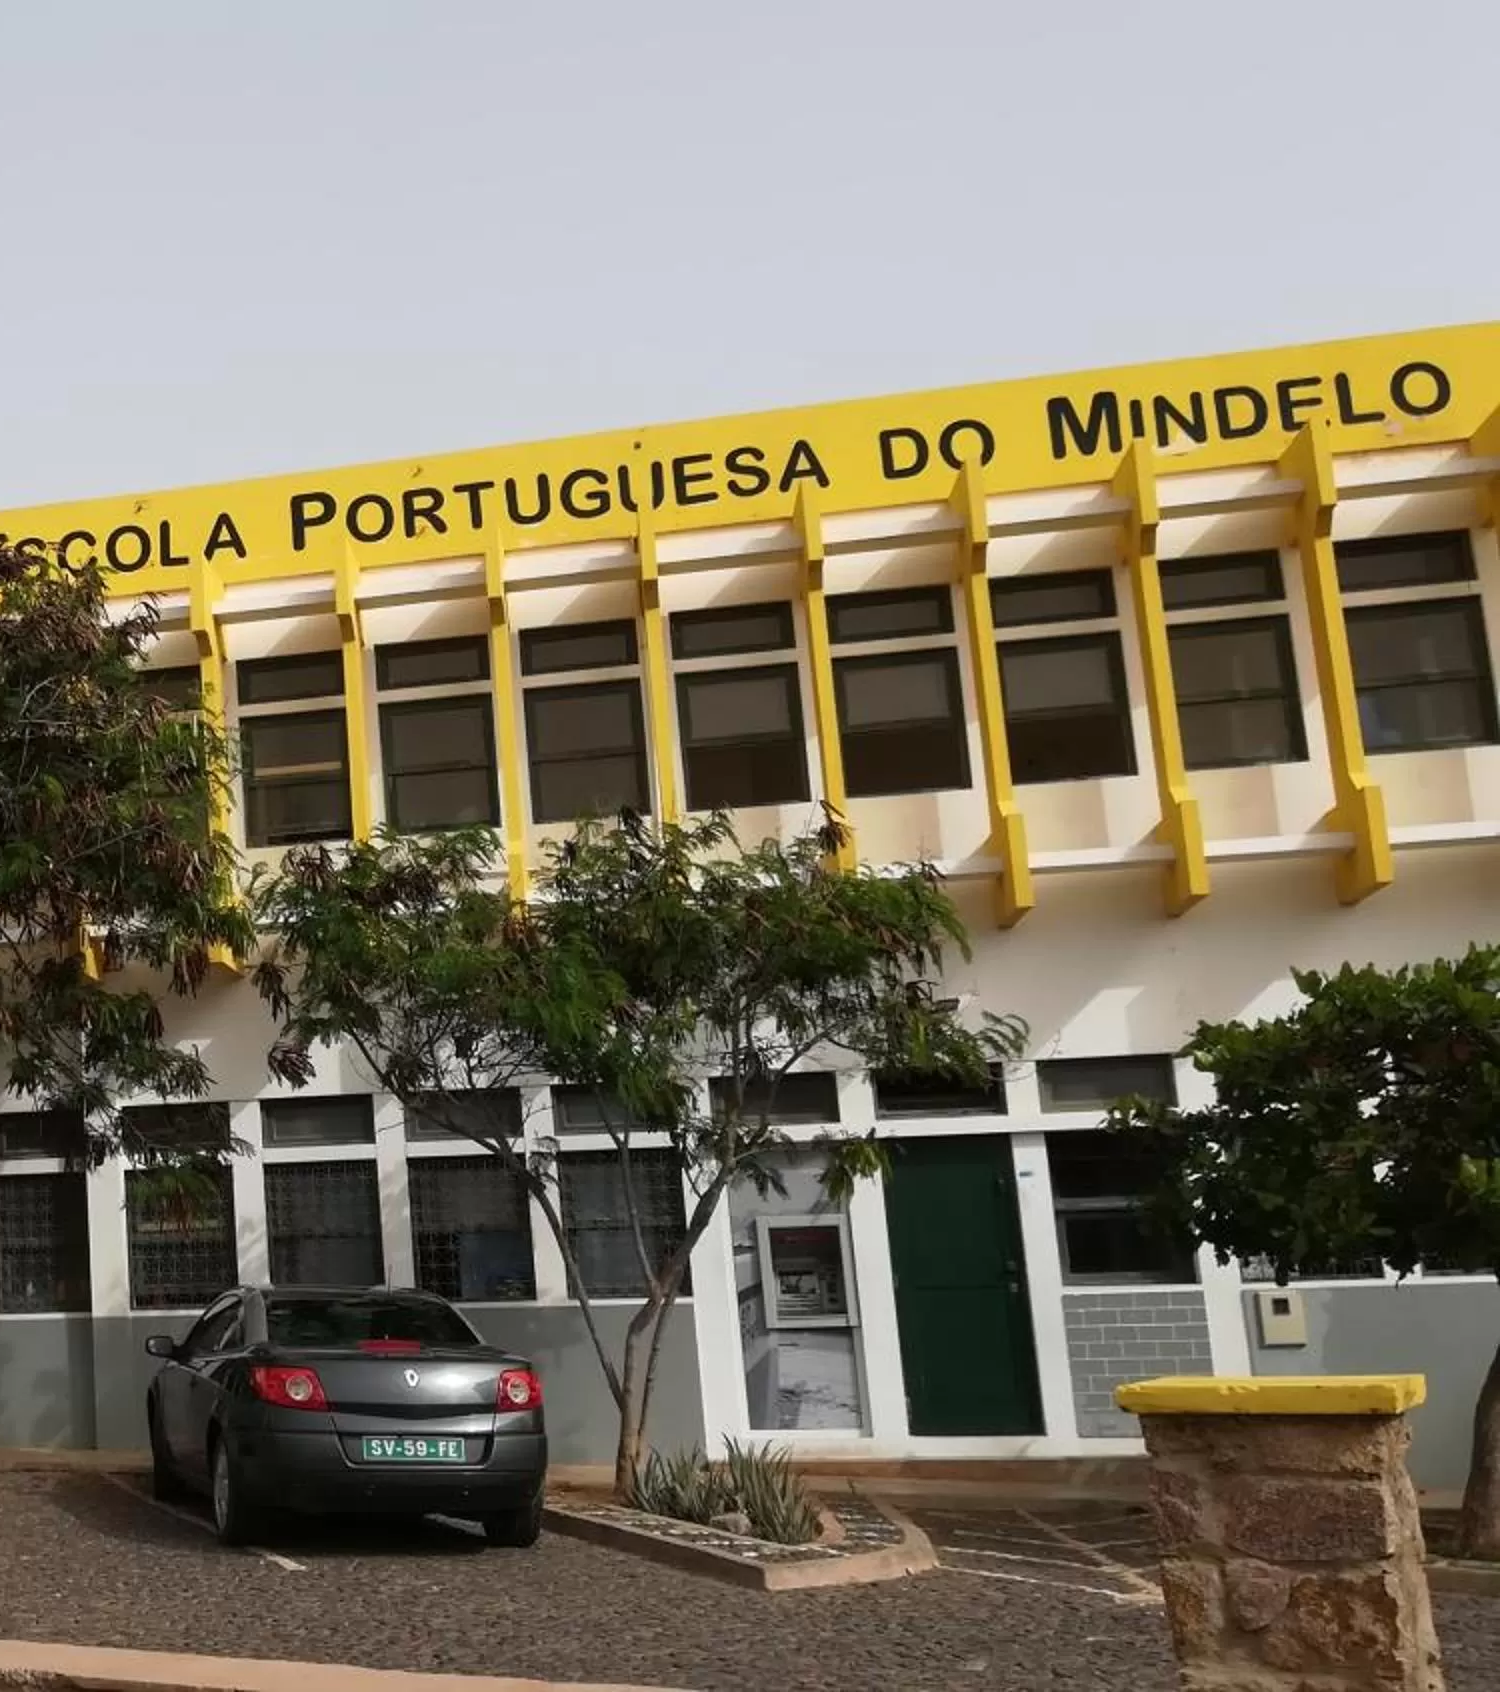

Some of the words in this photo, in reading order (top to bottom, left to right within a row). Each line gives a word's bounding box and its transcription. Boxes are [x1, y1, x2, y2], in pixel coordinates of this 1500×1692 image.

[289, 439, 831, 552] PORTUGUESA
[879, 419, 994, 480] DO
[1046, 361, 1451, 460] MINDELO
[371, 1439, 458, 1457] SV-59-FE
